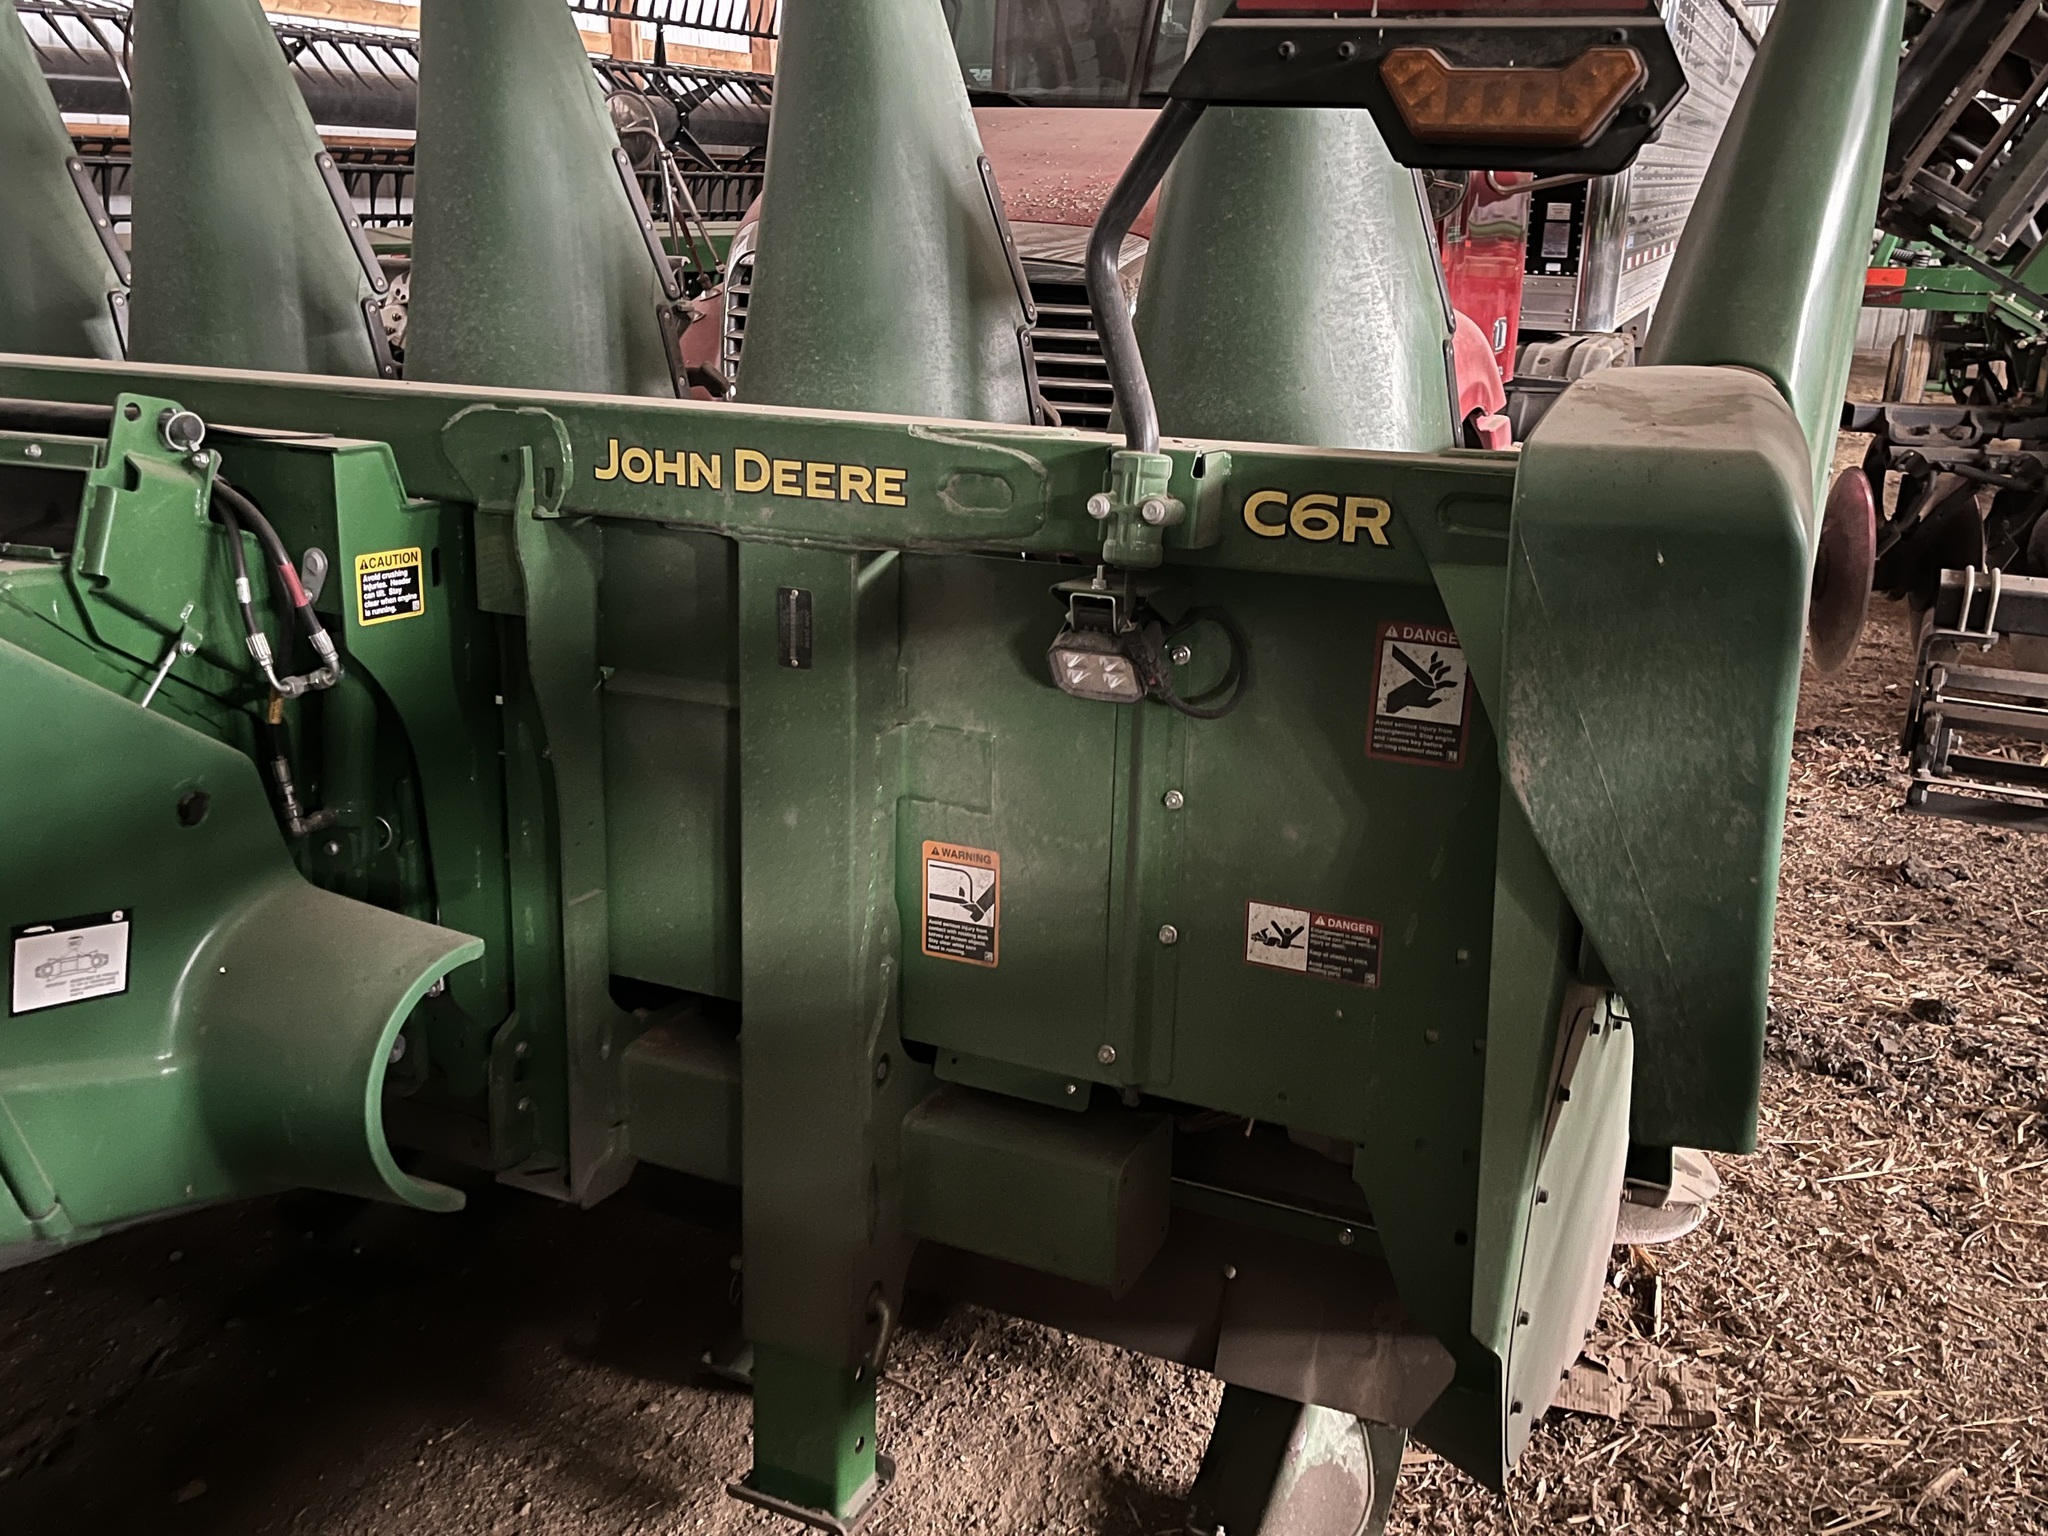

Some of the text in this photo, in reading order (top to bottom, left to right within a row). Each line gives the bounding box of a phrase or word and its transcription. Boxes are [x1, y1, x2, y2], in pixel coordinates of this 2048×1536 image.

[594, 438, 906, 506] JOHN DEERE
[1244, 490, 1391, 546] C6R
[369, 551, 418, 568] CAUTION
[363, 570, 408, 582] Avoid crushing
[390, 578, 411, 586] Header
[364, 592, 375, 600] can
[364, 593, 418, 608] clear when engine
[1403, 627, 1458, 644] DANGE
[1394, 721, 1417, 729] serious
[1419, 723, 1437, 733] injury
[1386, 736, 1409, 744] remove
[1411, 738, 1421, 746] key
[1423, 740, 1442, 748] before
[1419, 732, 1433, 740] Stop
[1435, 735, 1456, 743] engine
[1398, 746, 1424, 754] cleanout
[942, 848, 992, 864] WARNING
[1328, 919, 1373, 934] DANGER
